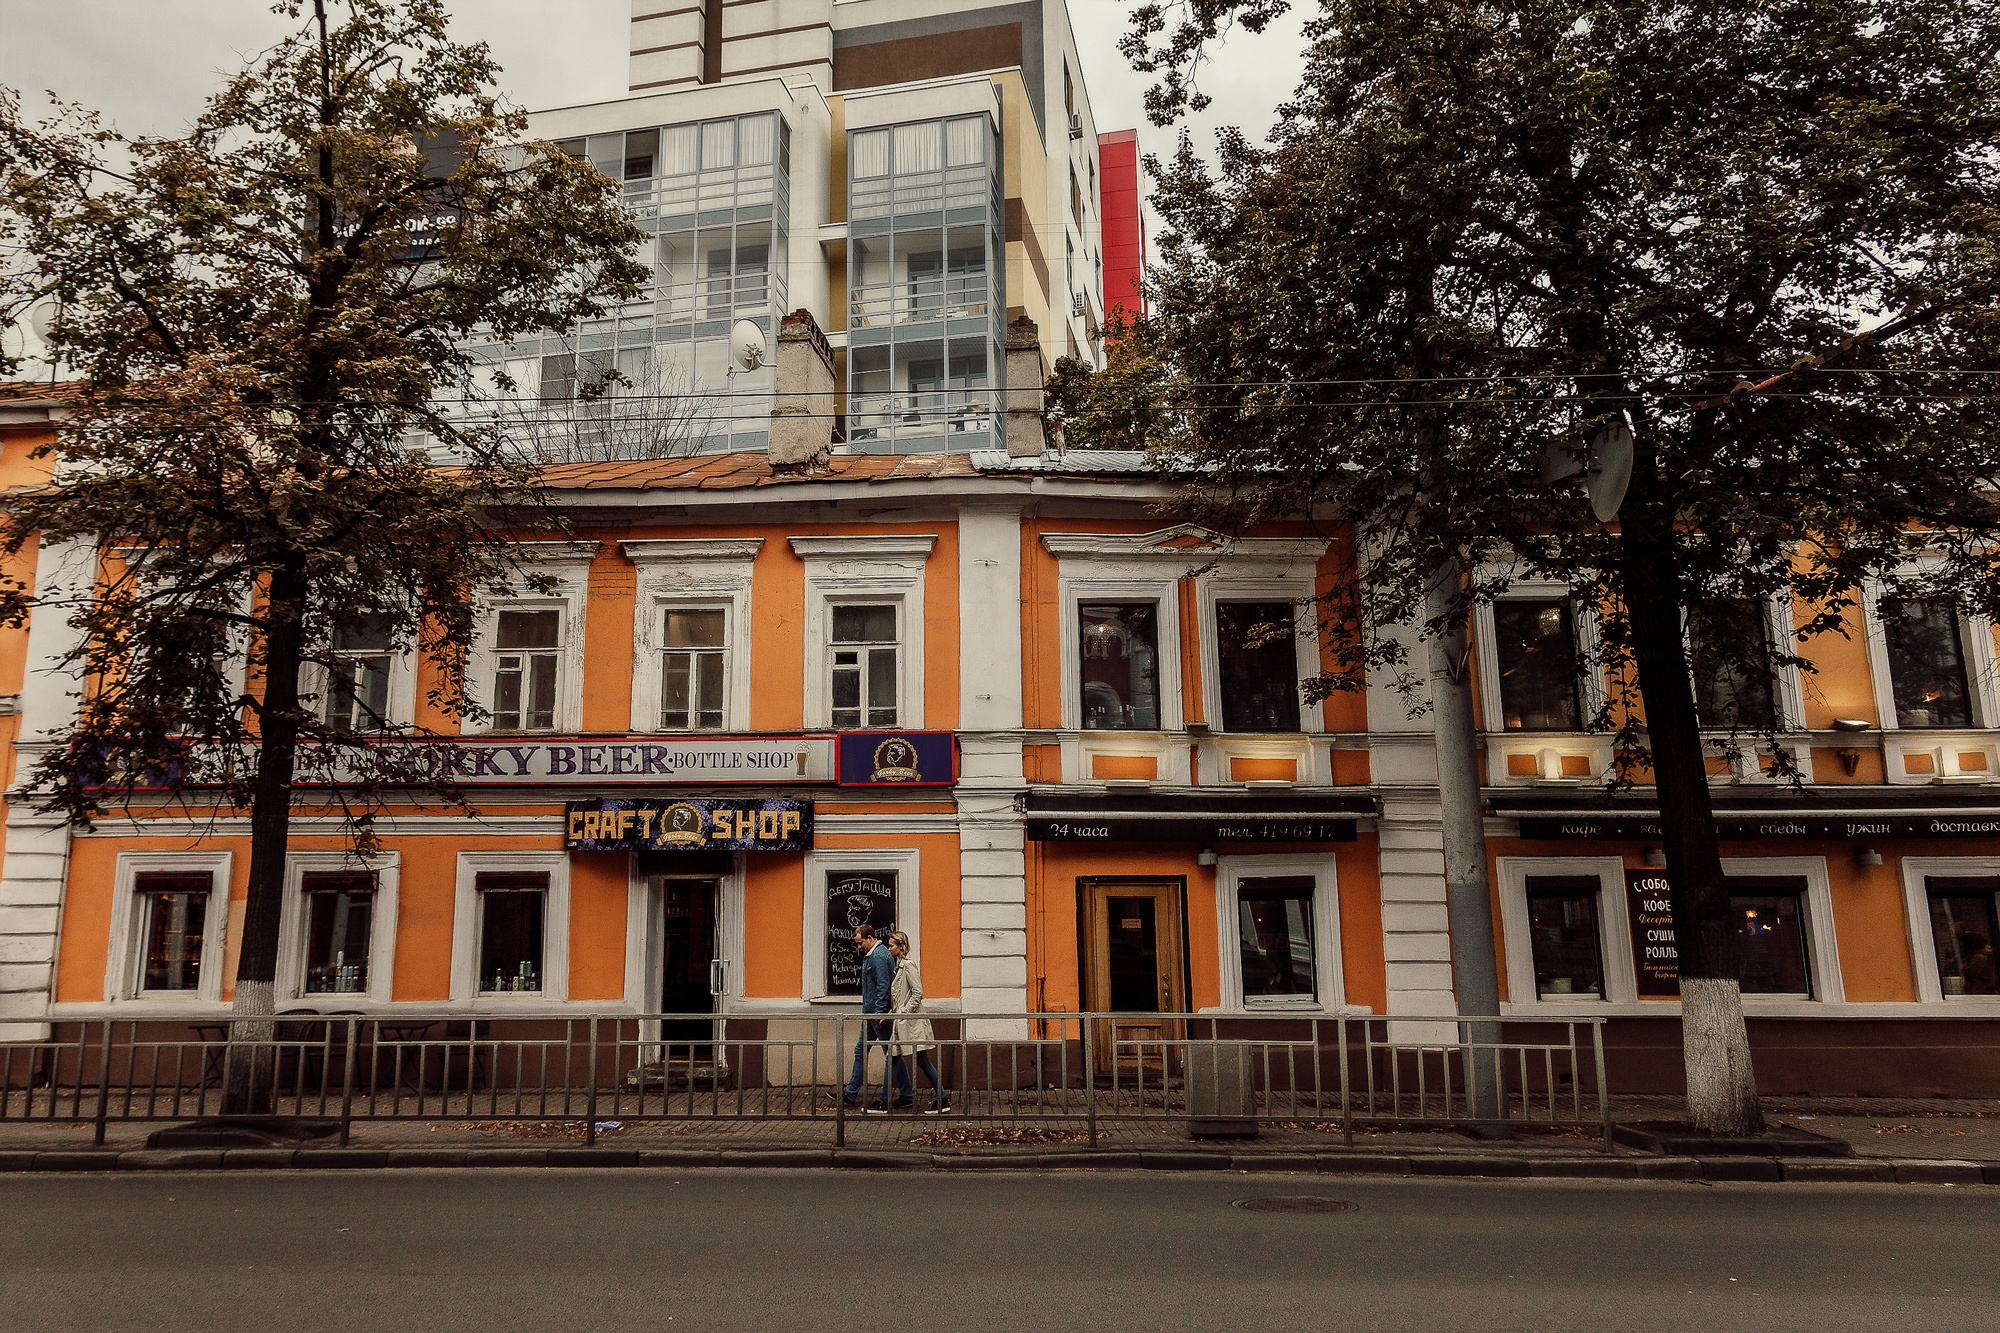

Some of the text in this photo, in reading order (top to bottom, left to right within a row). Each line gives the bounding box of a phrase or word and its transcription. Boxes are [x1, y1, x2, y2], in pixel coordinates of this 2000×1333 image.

[546, 744, 674, 776] BEER
[673, 751, 742, 769] BOTTLE
[746, 751, 794, 769] SHOP
[568, 810, 801, 840] CRAFT SHOP
[1073, 826, 1109, 837] часа
[1561, 822, 1601, 838] кофе
[1760, 820, 1807, 835] обеды
[1846, 822, 1891, 837] ужин
[1633, 878, 1670, 892] С СОБО
[1643, 899, 1672, 911] КОФЕ
[1638, 913, 1673, 926] Десерт
[1647, 929, 1675, 941] СУШИ
